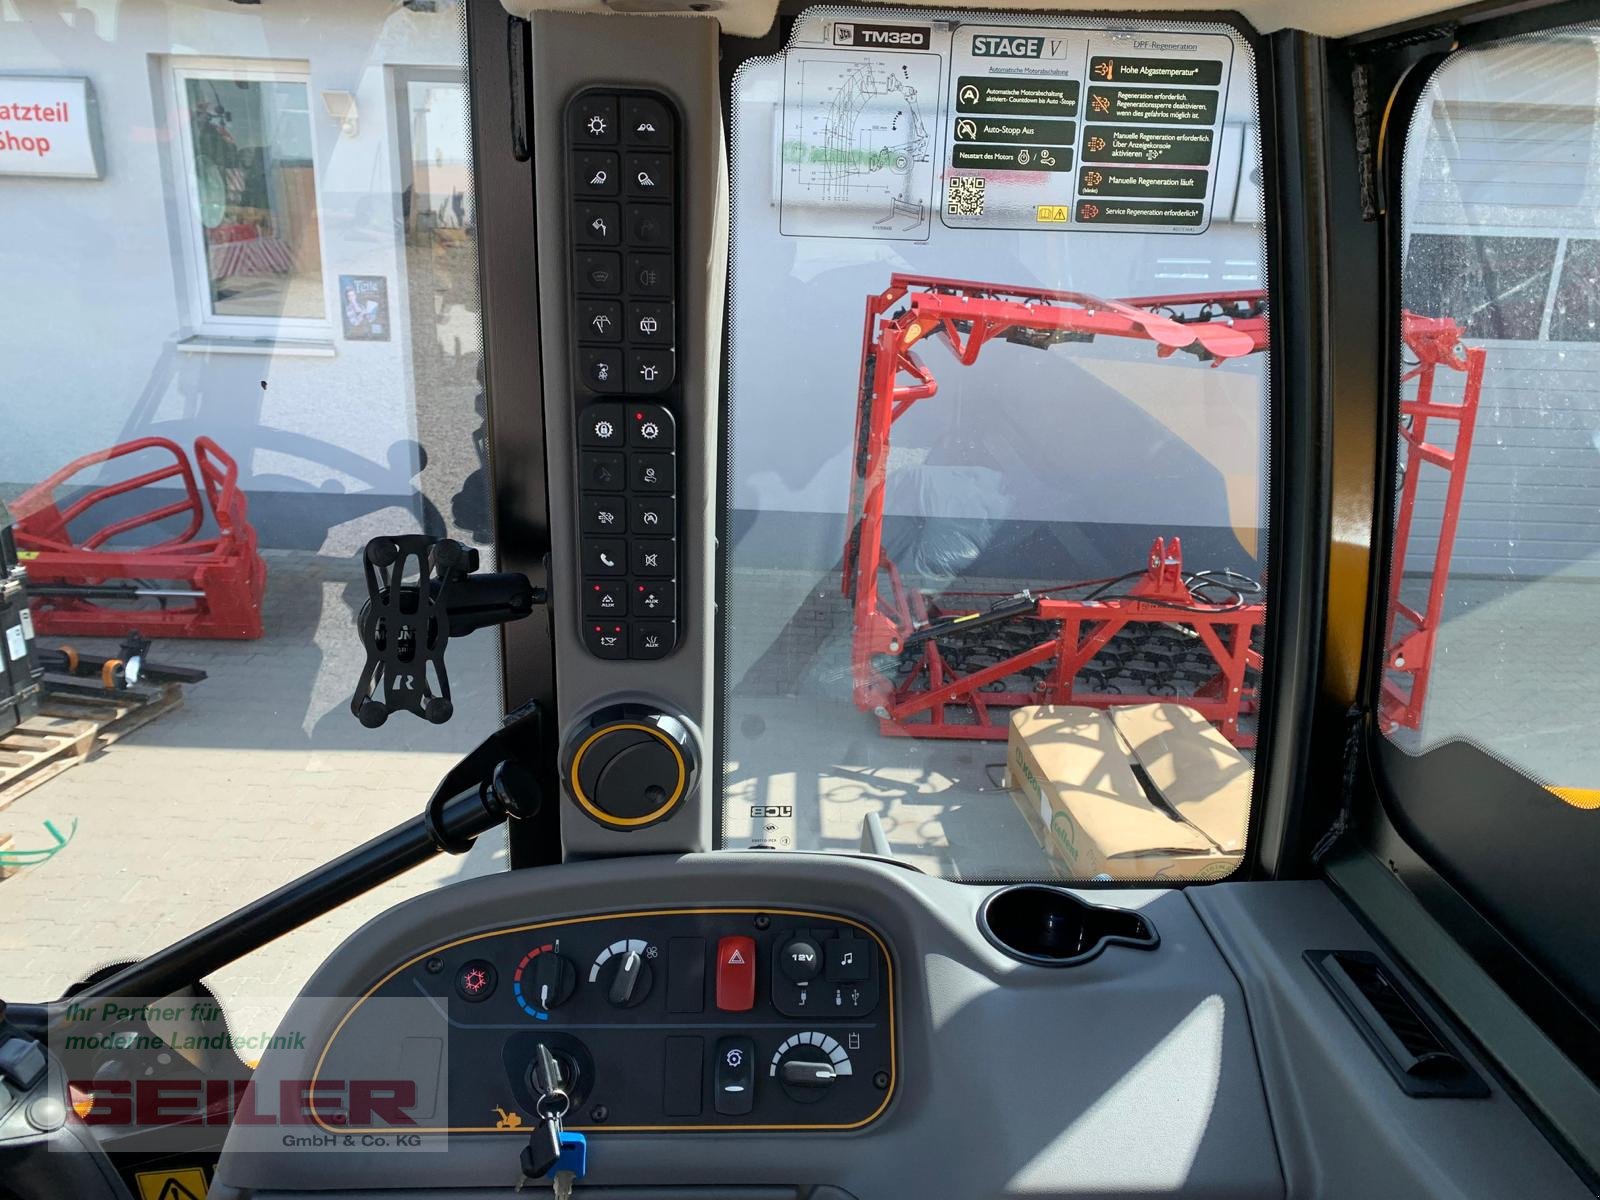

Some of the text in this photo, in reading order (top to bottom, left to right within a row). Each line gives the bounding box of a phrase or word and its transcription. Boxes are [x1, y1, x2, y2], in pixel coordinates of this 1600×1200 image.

[861, 30, 924, 45] TM320
[973, 37, 1062, 57] STAGE V
[989, 66, 1024, 74] Automatische
[1120, 66, 1139, 75] Hohe
[985, 88, 1064, 99] Automatische Motorabschaltung
[1117, 91, 1154, 100] Regeneration
[1008, 96, 1038, 104] Countdown
[1143, 110, 1169, 119] gefahrlos
[1169, 111, 1191, 120] möglich
[983, 125, 1035, 136] Auto-Stopp Aus
[1113, 132, 1139, 140] Manuelle
[1139, 132, 1176, 142] Regeneration
[1112, 140, 1172, 150] Über Anzeigekonsole
[959, 152, 984, 160] Neustart
[984, 152, 994, 160] des
[1111, 149, 1143, 157] aktivieren
[1108, 176, 1195, 187] Manuelle Regeneration läuft
[1105, 207, 1126, 216] Service
[1126, 208, 1163, 217] Regeneration
[791, 953, 815, 963] 12V
